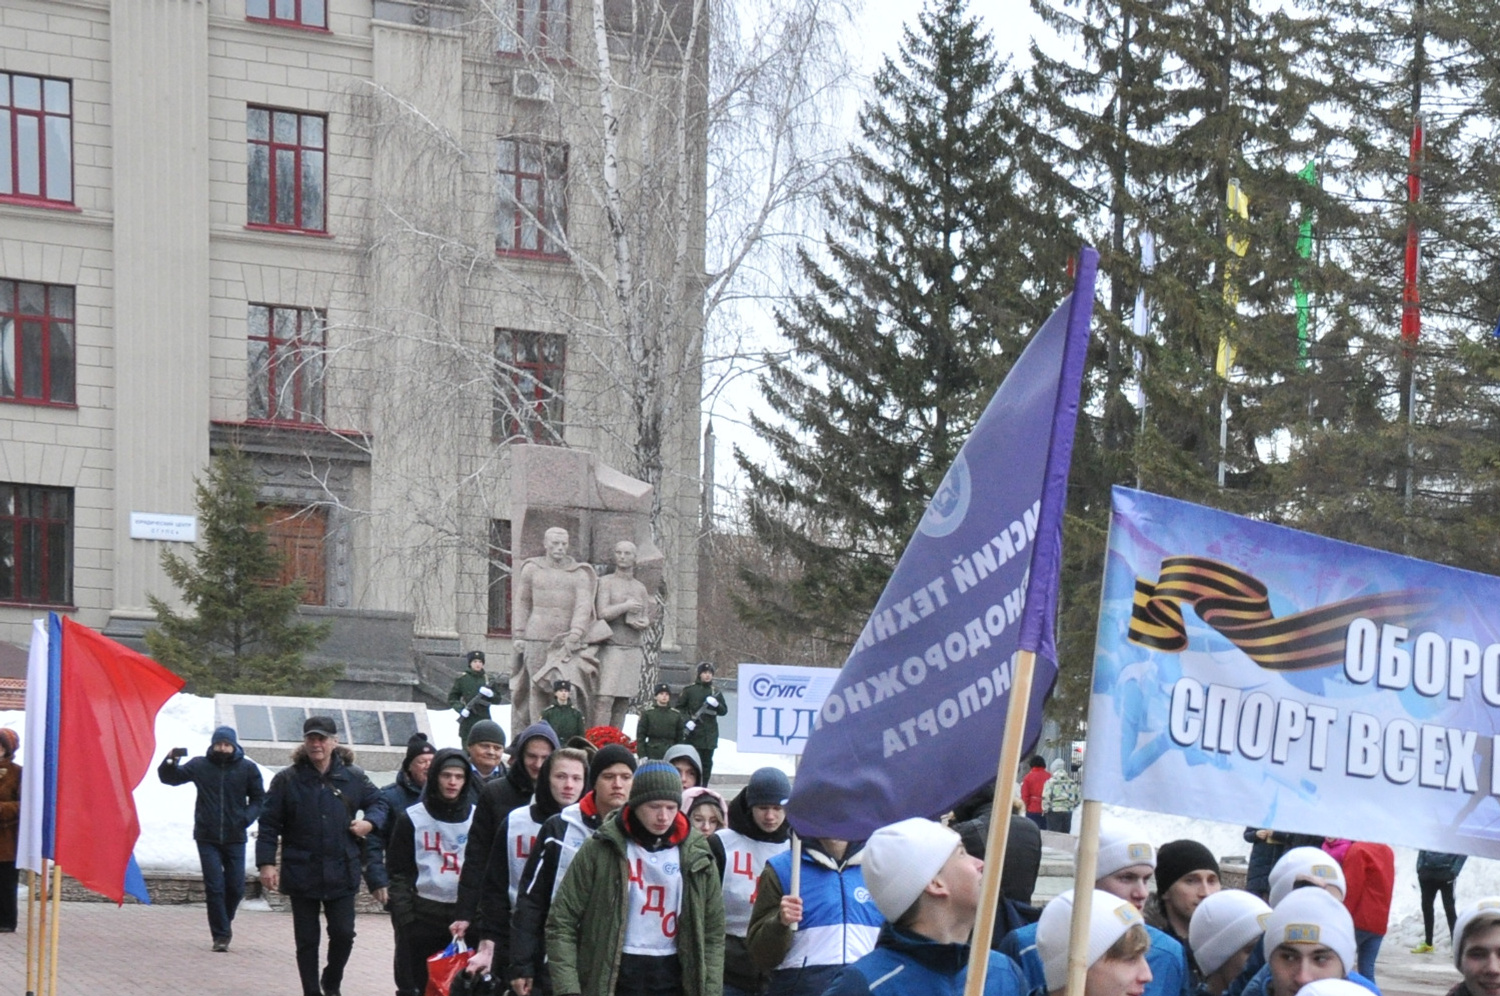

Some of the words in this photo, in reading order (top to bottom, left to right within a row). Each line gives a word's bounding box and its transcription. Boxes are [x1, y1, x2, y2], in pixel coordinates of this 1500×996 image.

[1169, 676, 1338, 772] СПОРТ
[1346, 711, 1479, 793] ВСЕХ
[424, 831, 461, 876] ЦД
